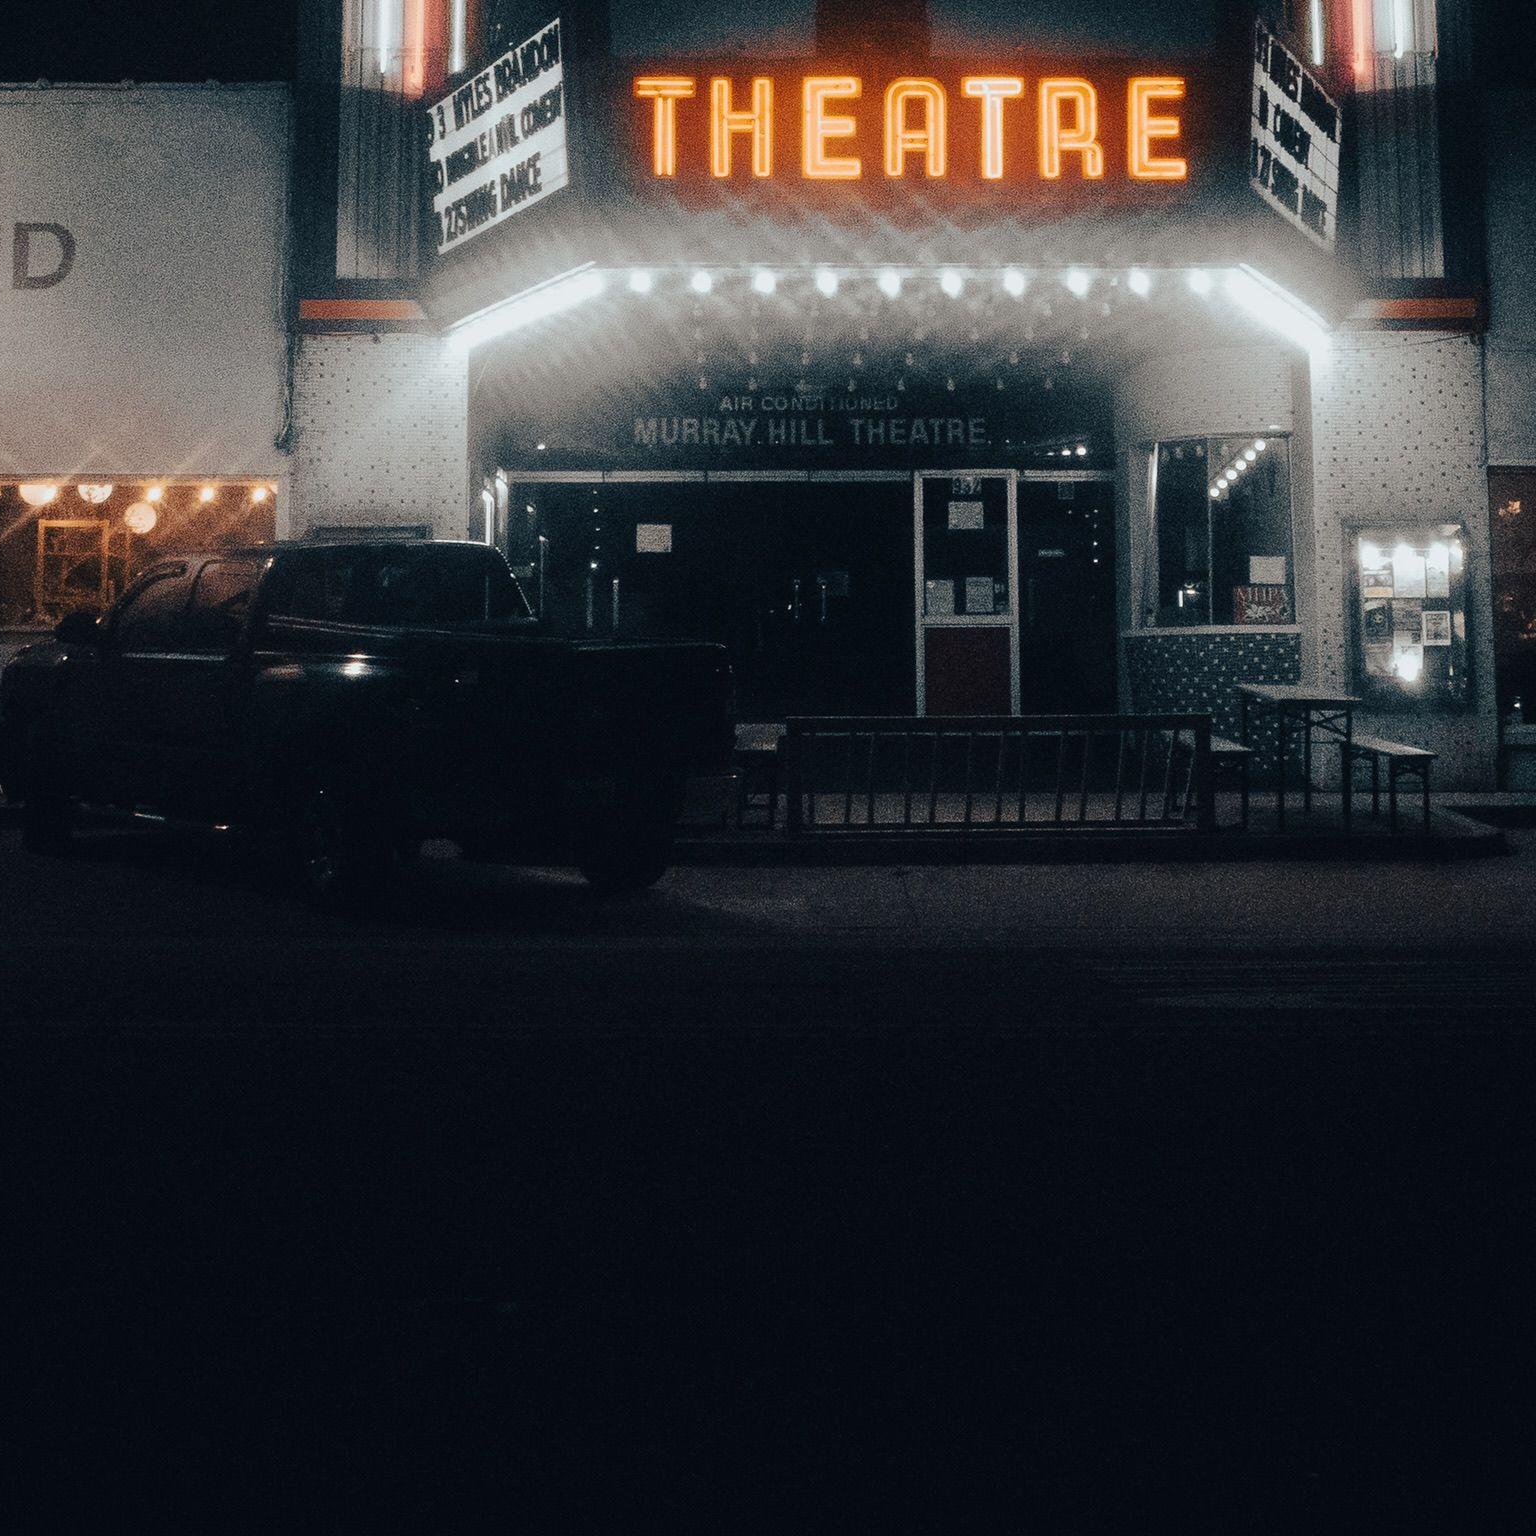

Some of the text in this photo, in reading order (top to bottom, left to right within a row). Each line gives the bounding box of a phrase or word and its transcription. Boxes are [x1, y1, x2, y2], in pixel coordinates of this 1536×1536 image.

[637, 76, 1187, 181] THEATRE
[719, 394, 754, 411] AIR
[634, 417, 987, 445] MURRAY HILL THEATRE
